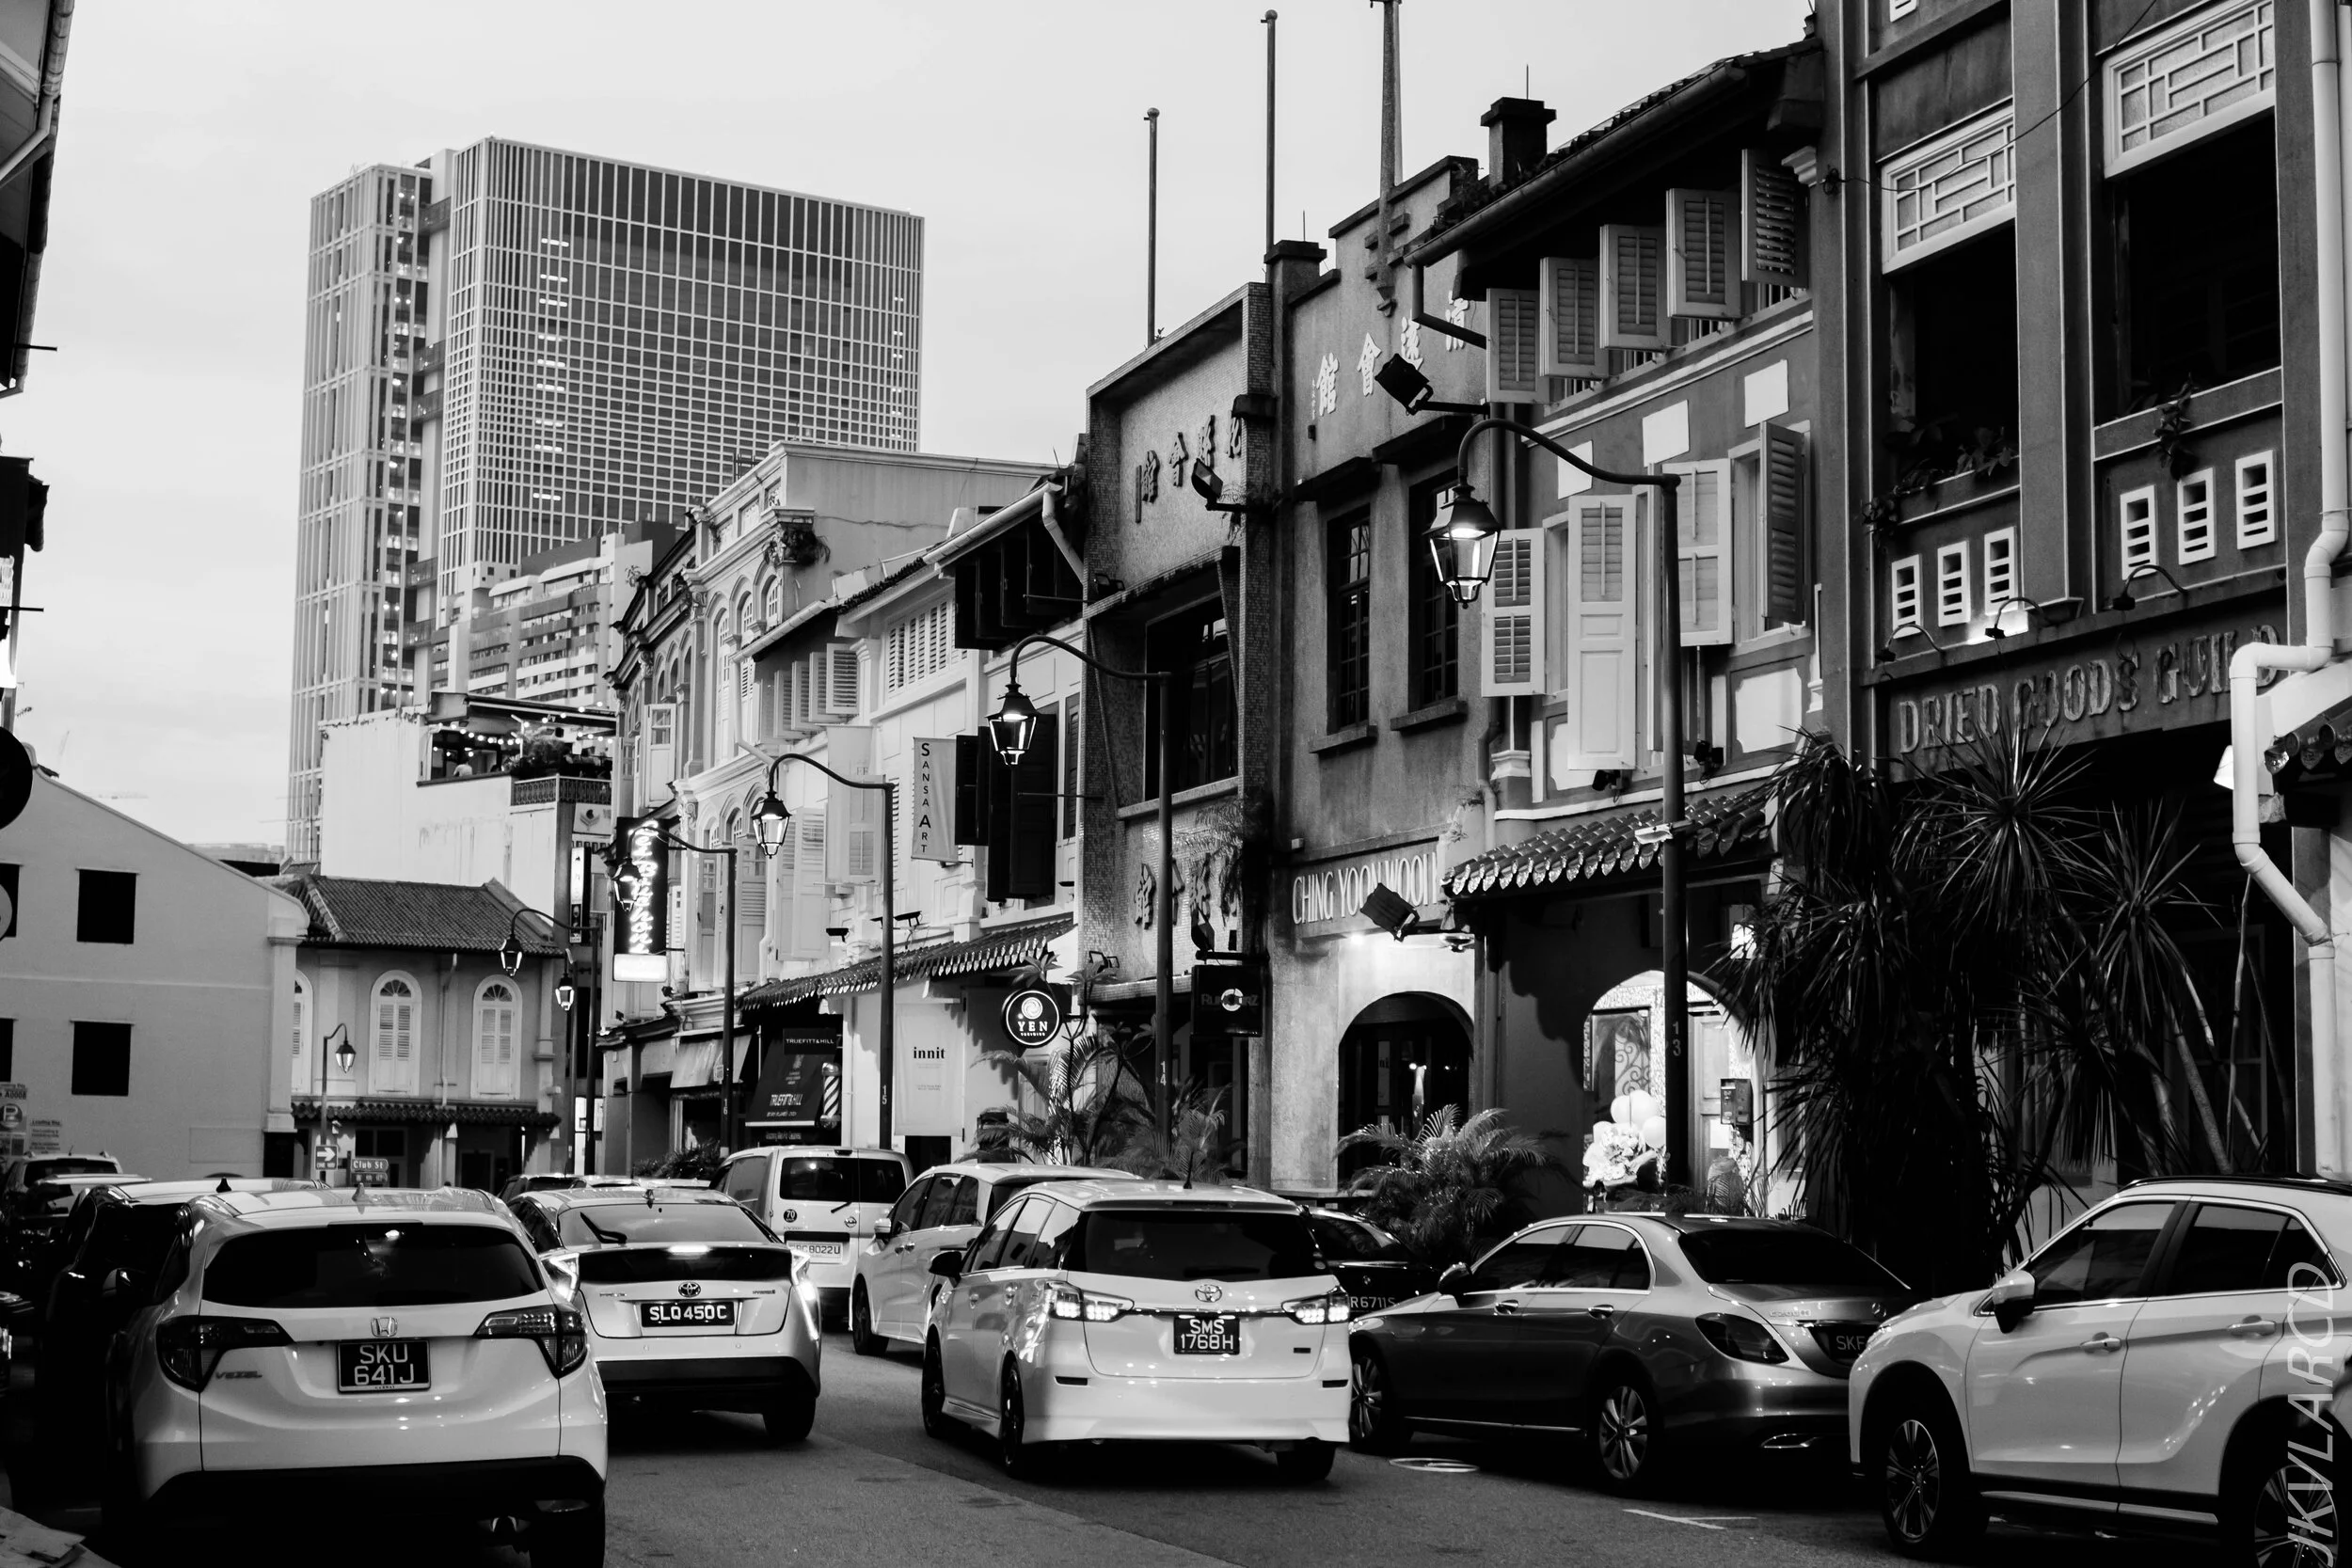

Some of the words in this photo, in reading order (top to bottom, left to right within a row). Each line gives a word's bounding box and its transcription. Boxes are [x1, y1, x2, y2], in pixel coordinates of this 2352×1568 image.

[1898, 682, 2001, 753] DRIED
[2012, 656, 2140, 730] GOODS
[921, 742, 930, 807] SANSA
[918, 814, 931, 853] ART
[1292, 871, 1334, 925] CHING
[1017, 1021, 1048, 1032] YEN
[913, 1046, 946, 1059] innit
[353, 1160, 372, 1169] Club
[374, 1161, 383, 1169] St
[787, 1209, 796, 1219] 70
[1189, 1319, 1225, 1335] SMS
[1181, 1334, 1233, 1350] 1768H
[359, 1343, 408, 1364] SKU
[354, 1364, 415, 1386] 641J
